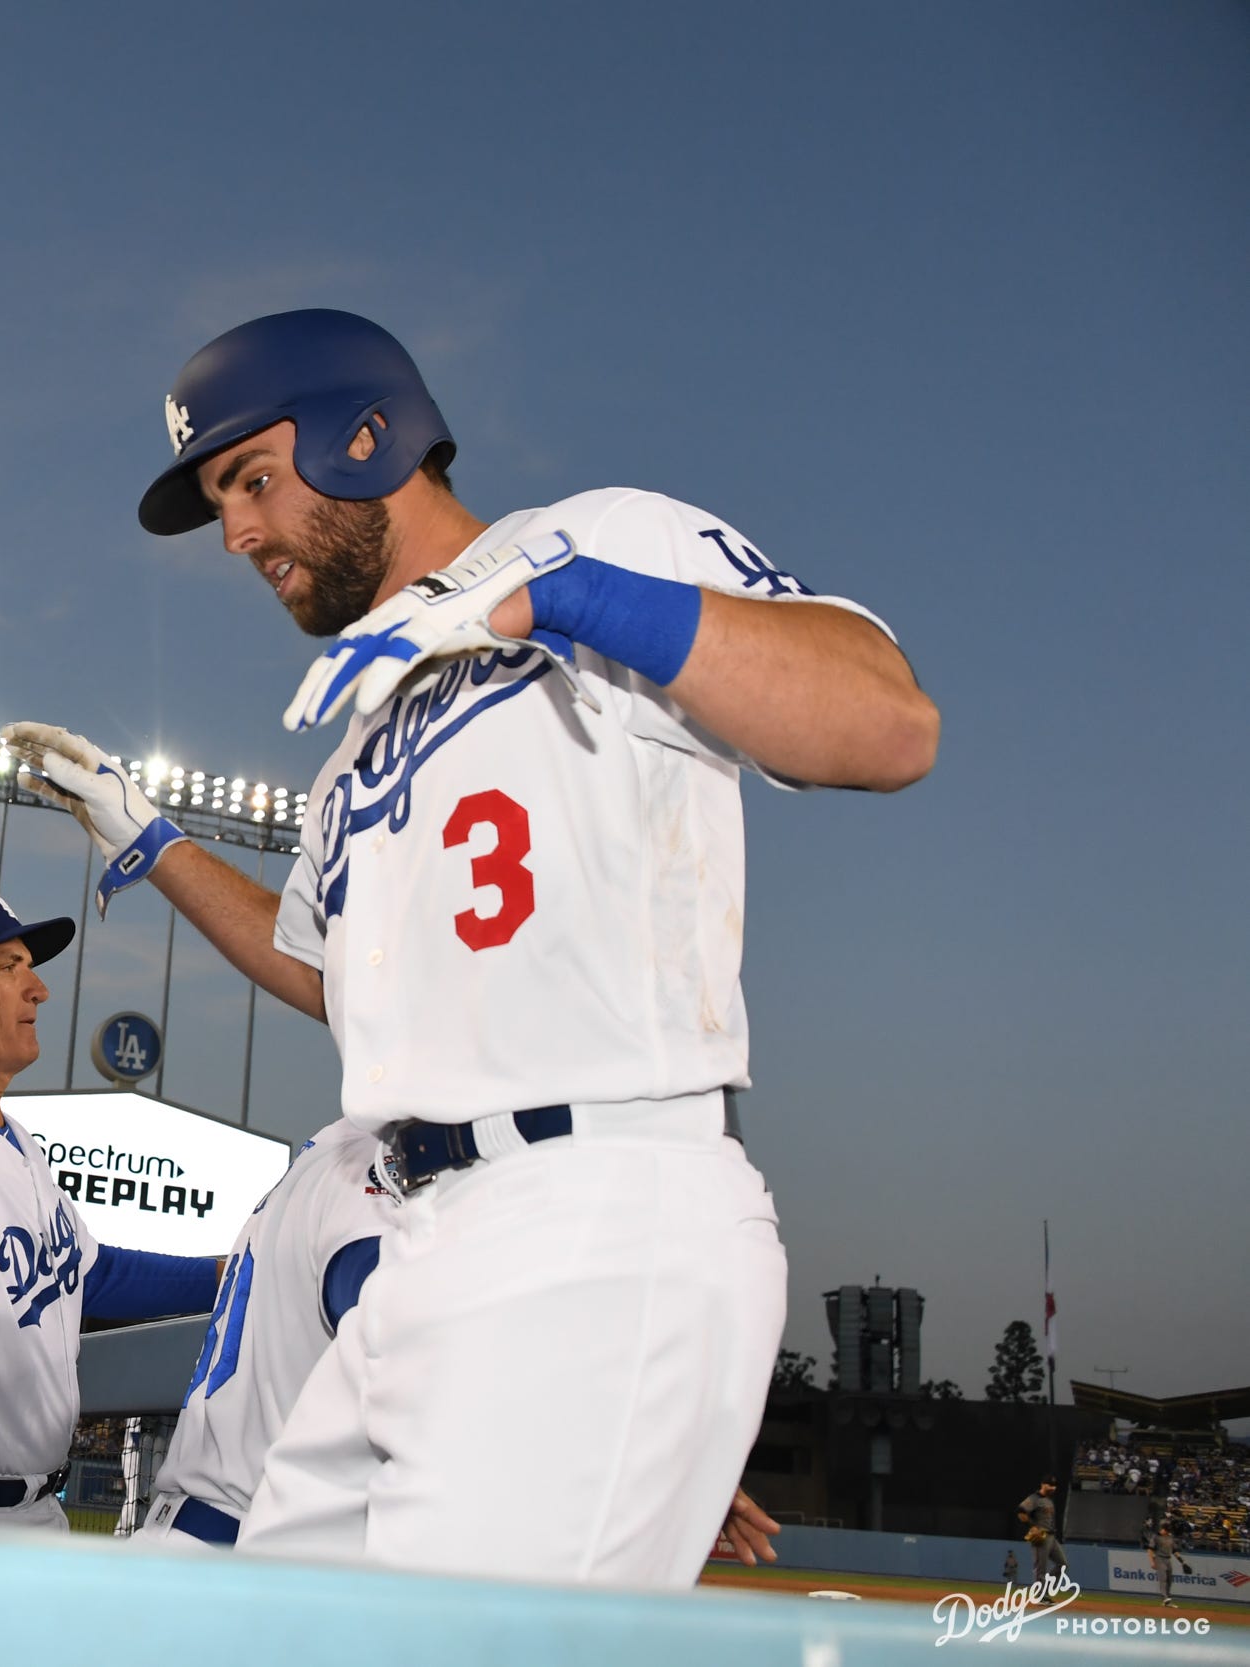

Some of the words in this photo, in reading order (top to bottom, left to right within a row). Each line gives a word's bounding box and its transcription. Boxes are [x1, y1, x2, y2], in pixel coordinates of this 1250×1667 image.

[317, 648, 552, 919] Ddge
[442, 788, 535, 952] 3
[115, 1022, 146, 1070] LA
[58, 1169, 215, 1218] REPLAY
[1113, 1566, 1146, 1580] Bank
[1171, 1573, 1217, 1586] merica
